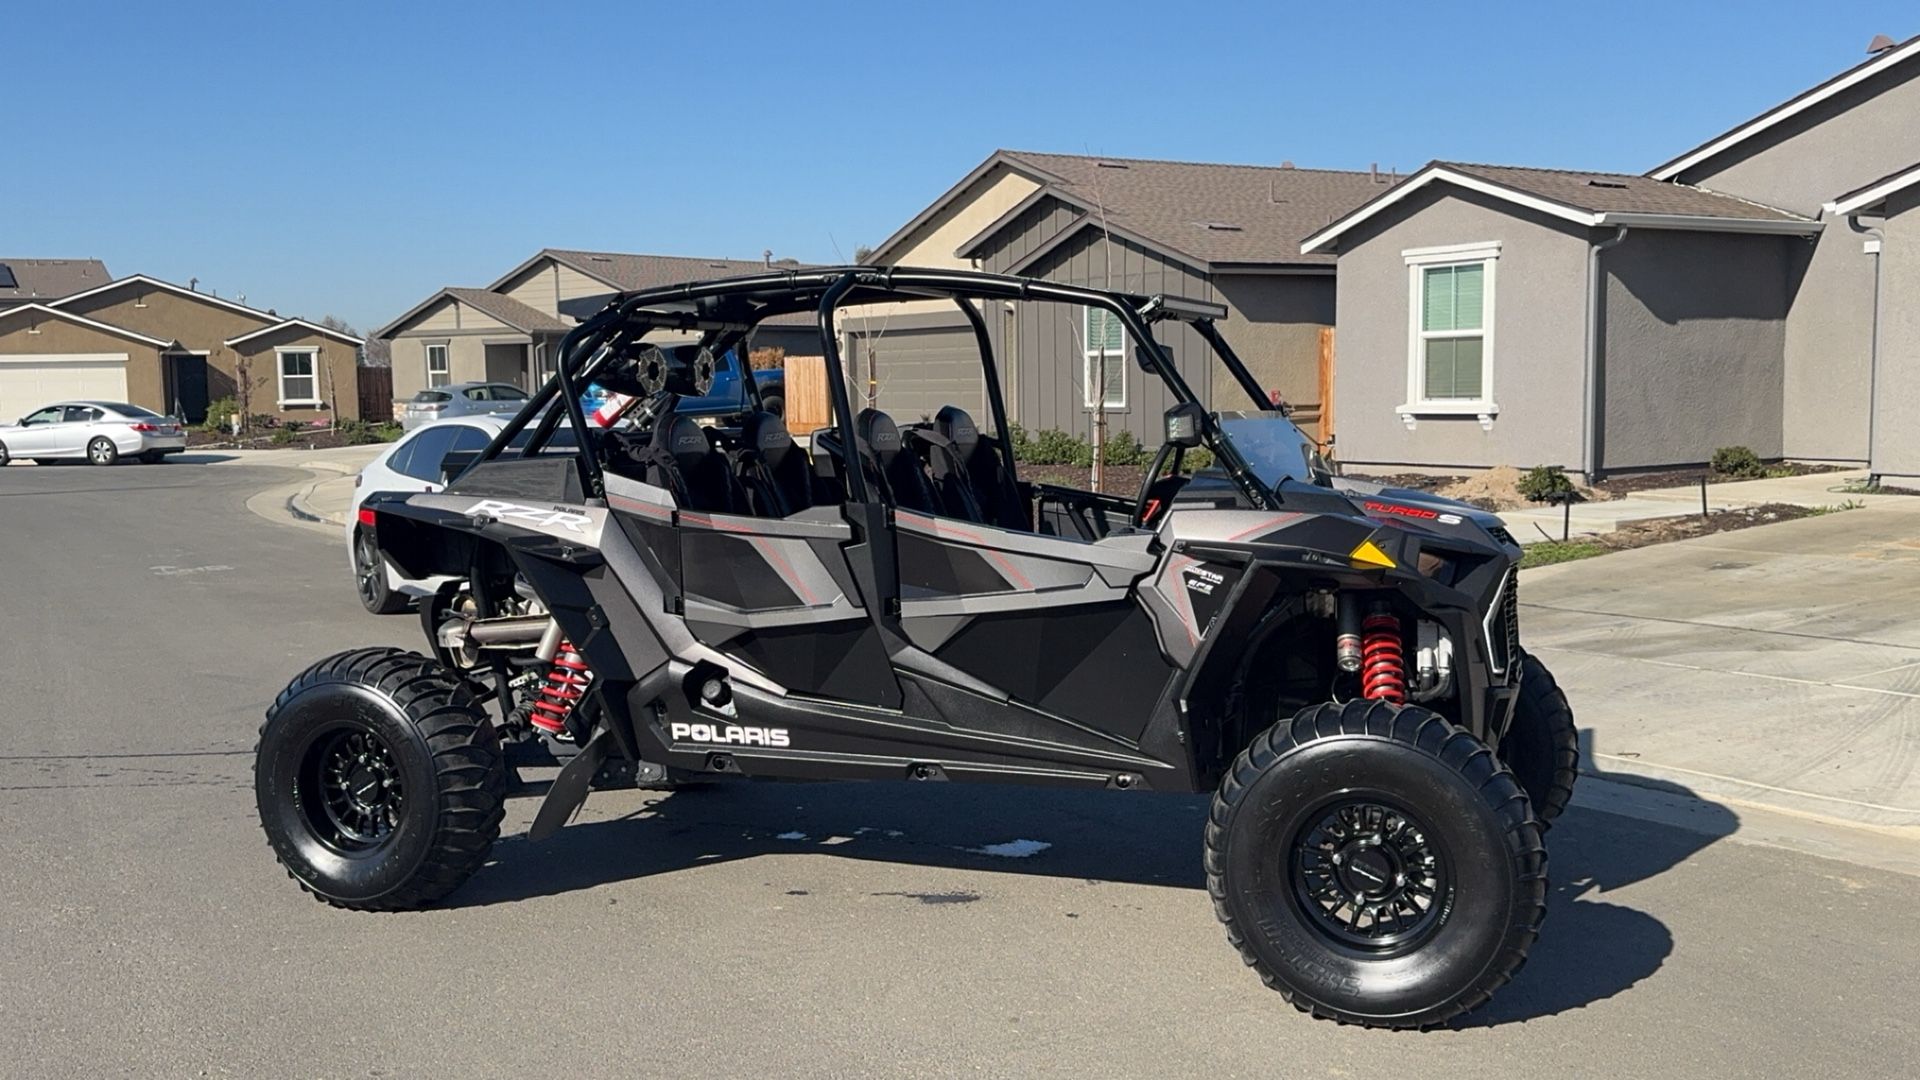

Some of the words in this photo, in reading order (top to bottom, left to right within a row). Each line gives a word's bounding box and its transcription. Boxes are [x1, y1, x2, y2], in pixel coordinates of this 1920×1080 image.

[678, 435, 703, 446] RZR
[877, 432, 896, 442] RZR
[464, 499, 593, 533] RZR
[553, 505, 586, 516] POLARIS
[1364, 501, 1437, 519] TURBO
[1437, 514, 1463, 525] S
[671, 722, 791, 747] POLARIS
